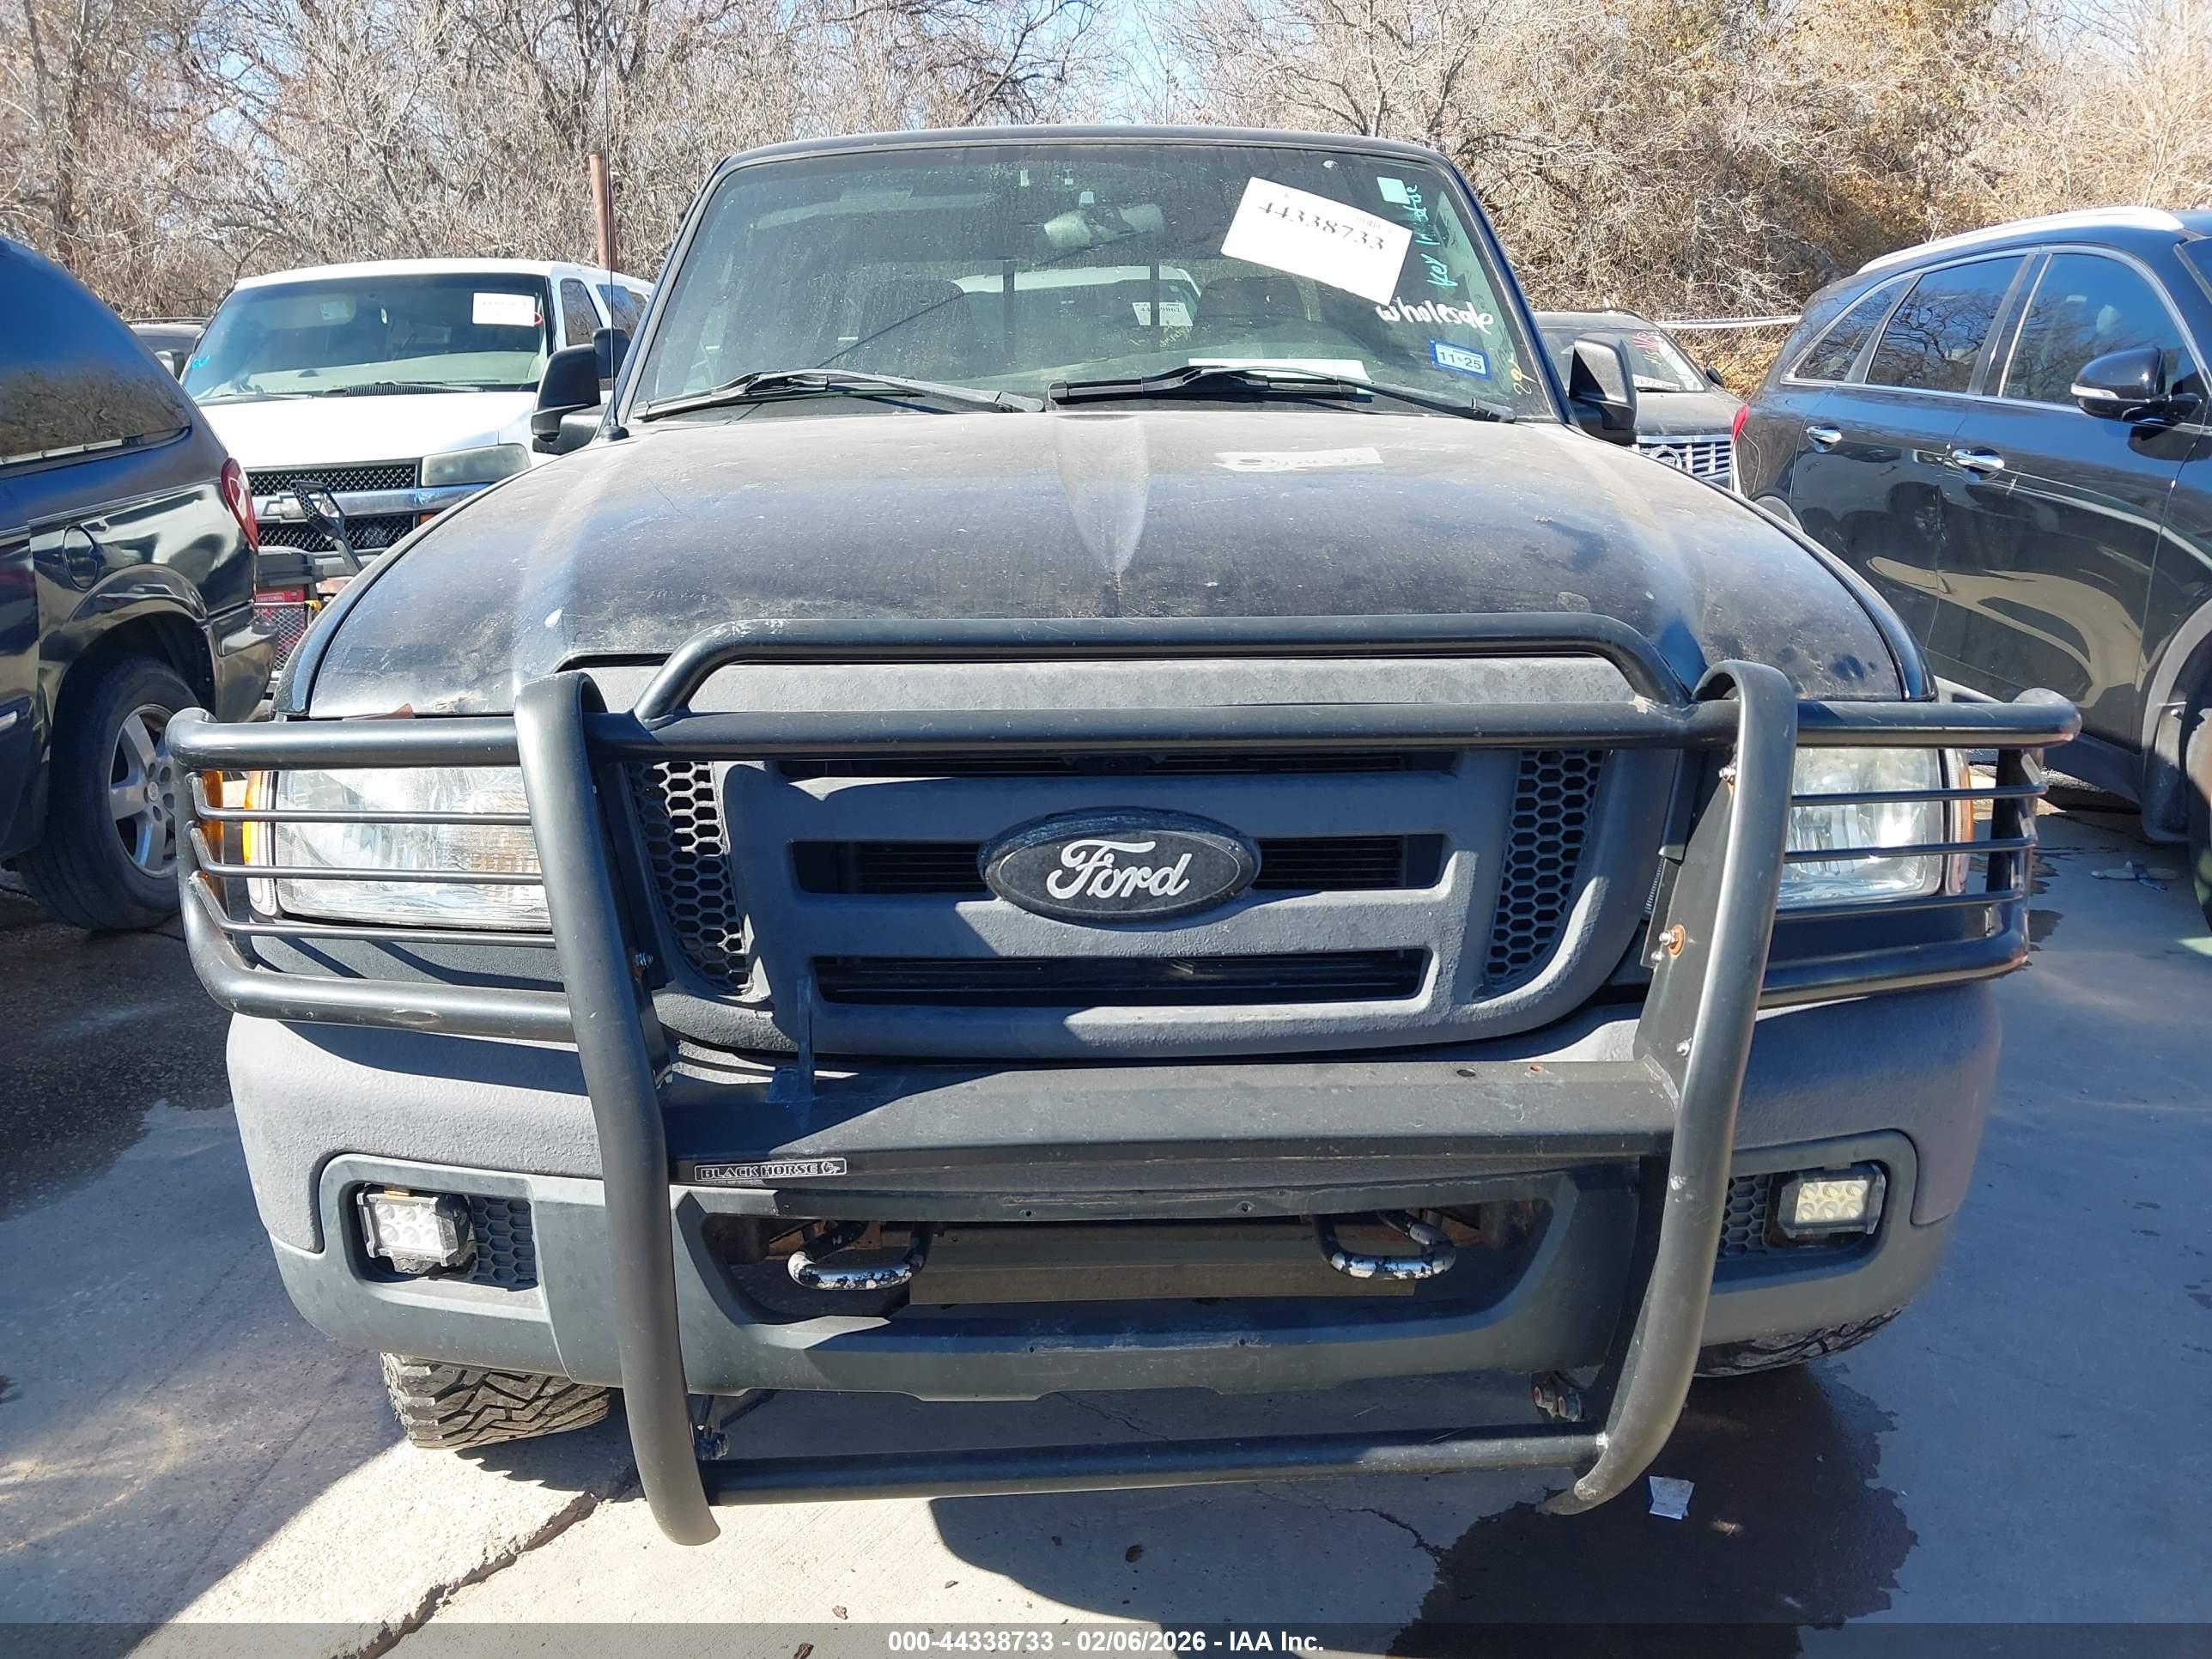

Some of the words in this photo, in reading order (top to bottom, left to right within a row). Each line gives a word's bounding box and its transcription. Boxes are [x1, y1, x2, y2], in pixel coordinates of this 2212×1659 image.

[1258, 202, 1384, 250] 44338733
[1046, 839, 1194, 900] Ford
[700, 1166, 760, 1180] BLACK
[761, 1163, 819, 1178] HORSE
